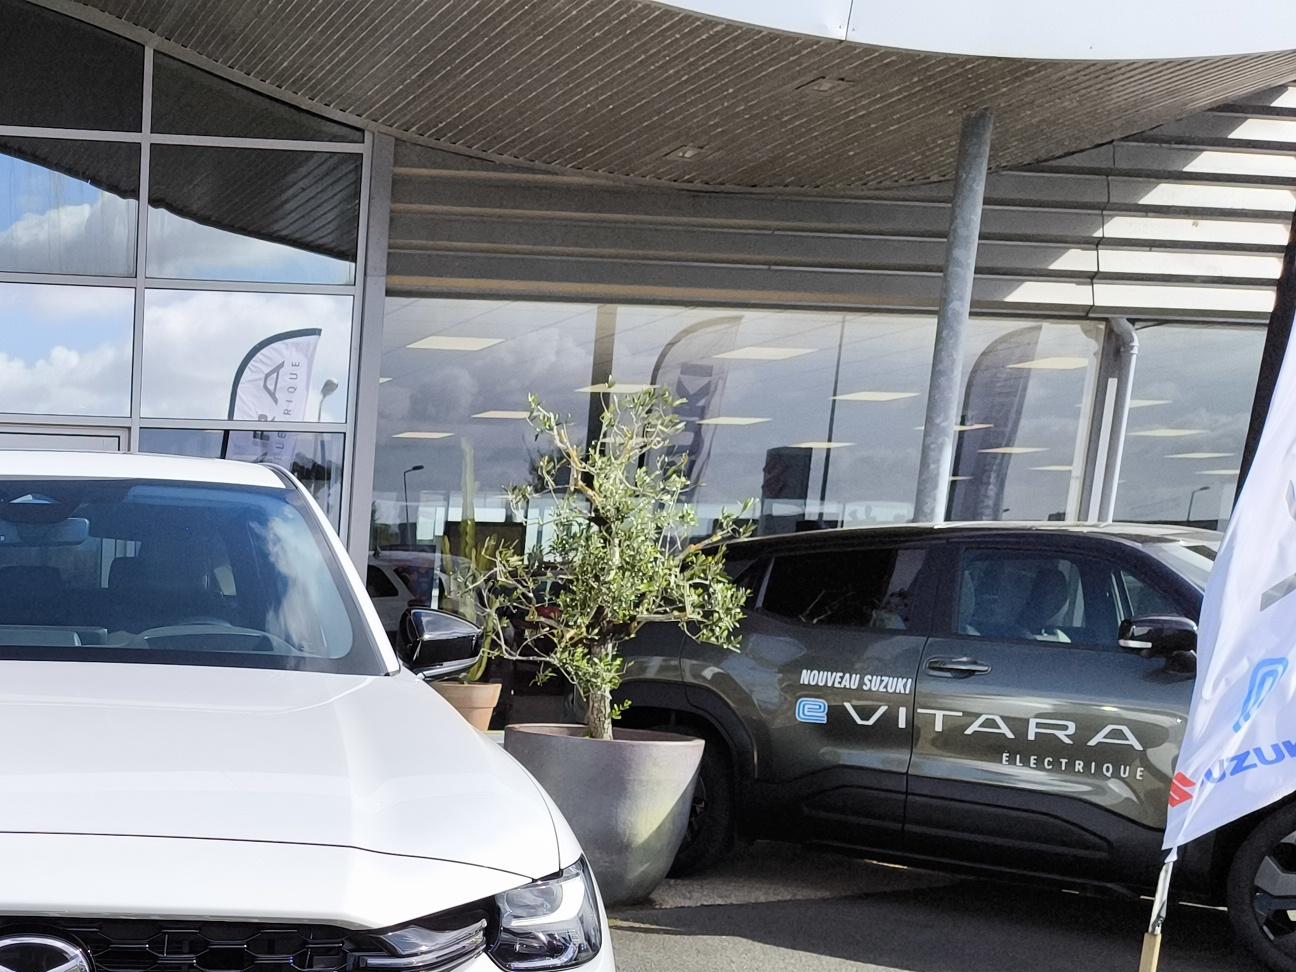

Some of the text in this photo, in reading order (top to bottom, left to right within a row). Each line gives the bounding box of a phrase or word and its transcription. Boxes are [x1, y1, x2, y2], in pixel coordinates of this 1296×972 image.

[800, 669, 913, 695] NOUVEAU SUZUKI
[843, 702, 1144, 751] VITARA
[1002, 750, 1144, 780] ÉLECTRIQUE
[1201, 739, 1296, 786] UZU
